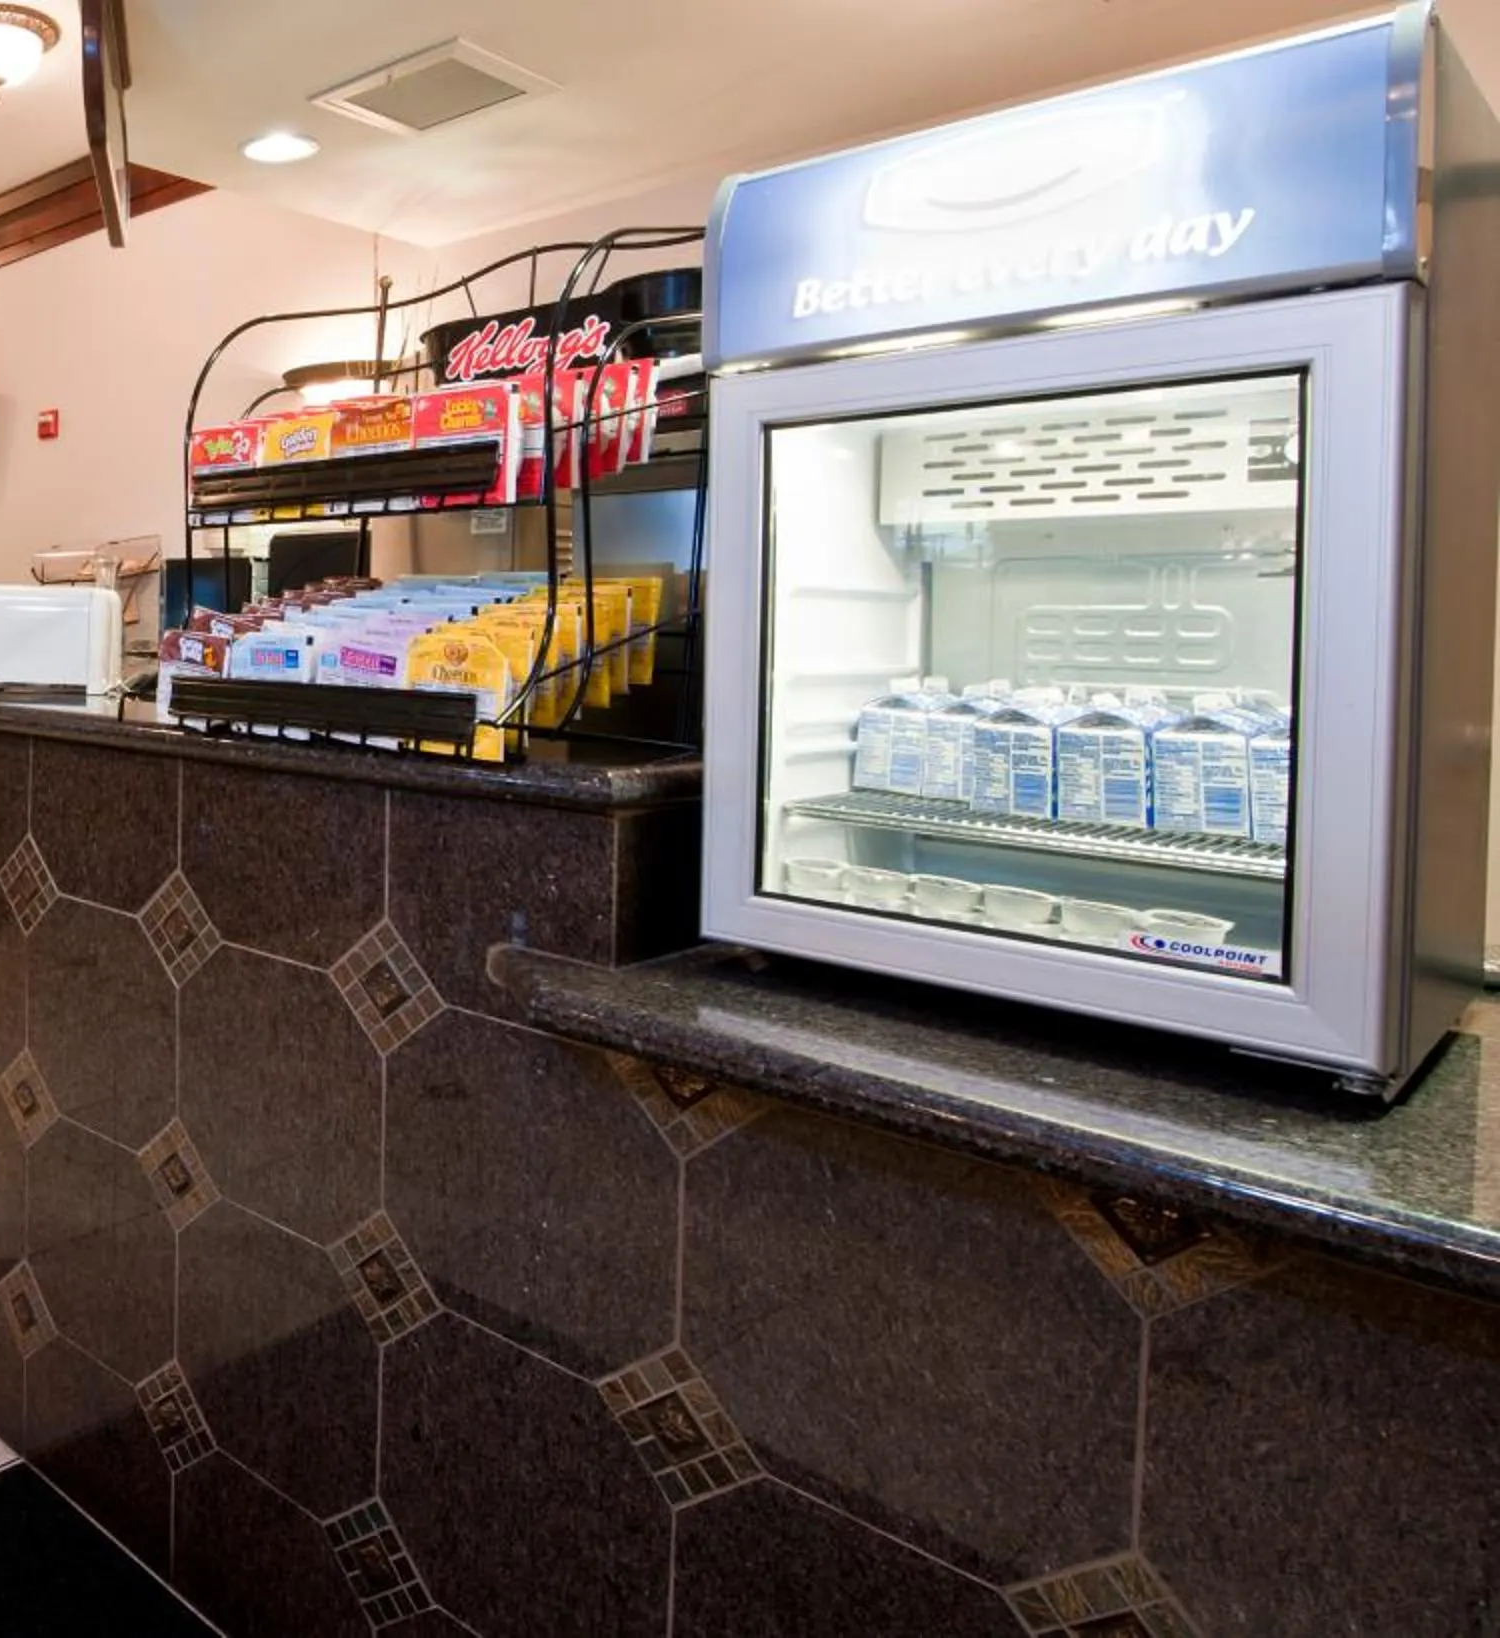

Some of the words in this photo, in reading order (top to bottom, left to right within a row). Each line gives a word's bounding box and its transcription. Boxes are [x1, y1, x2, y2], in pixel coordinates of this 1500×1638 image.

[792, 266, 933, 319] Better
[950, 234, 1115, 293] every
[1127, 207, 1255, 261] day
[445, 314, 611, 381] Kellogg's
[1169, 940, 1269, 965] COOLPOINT
